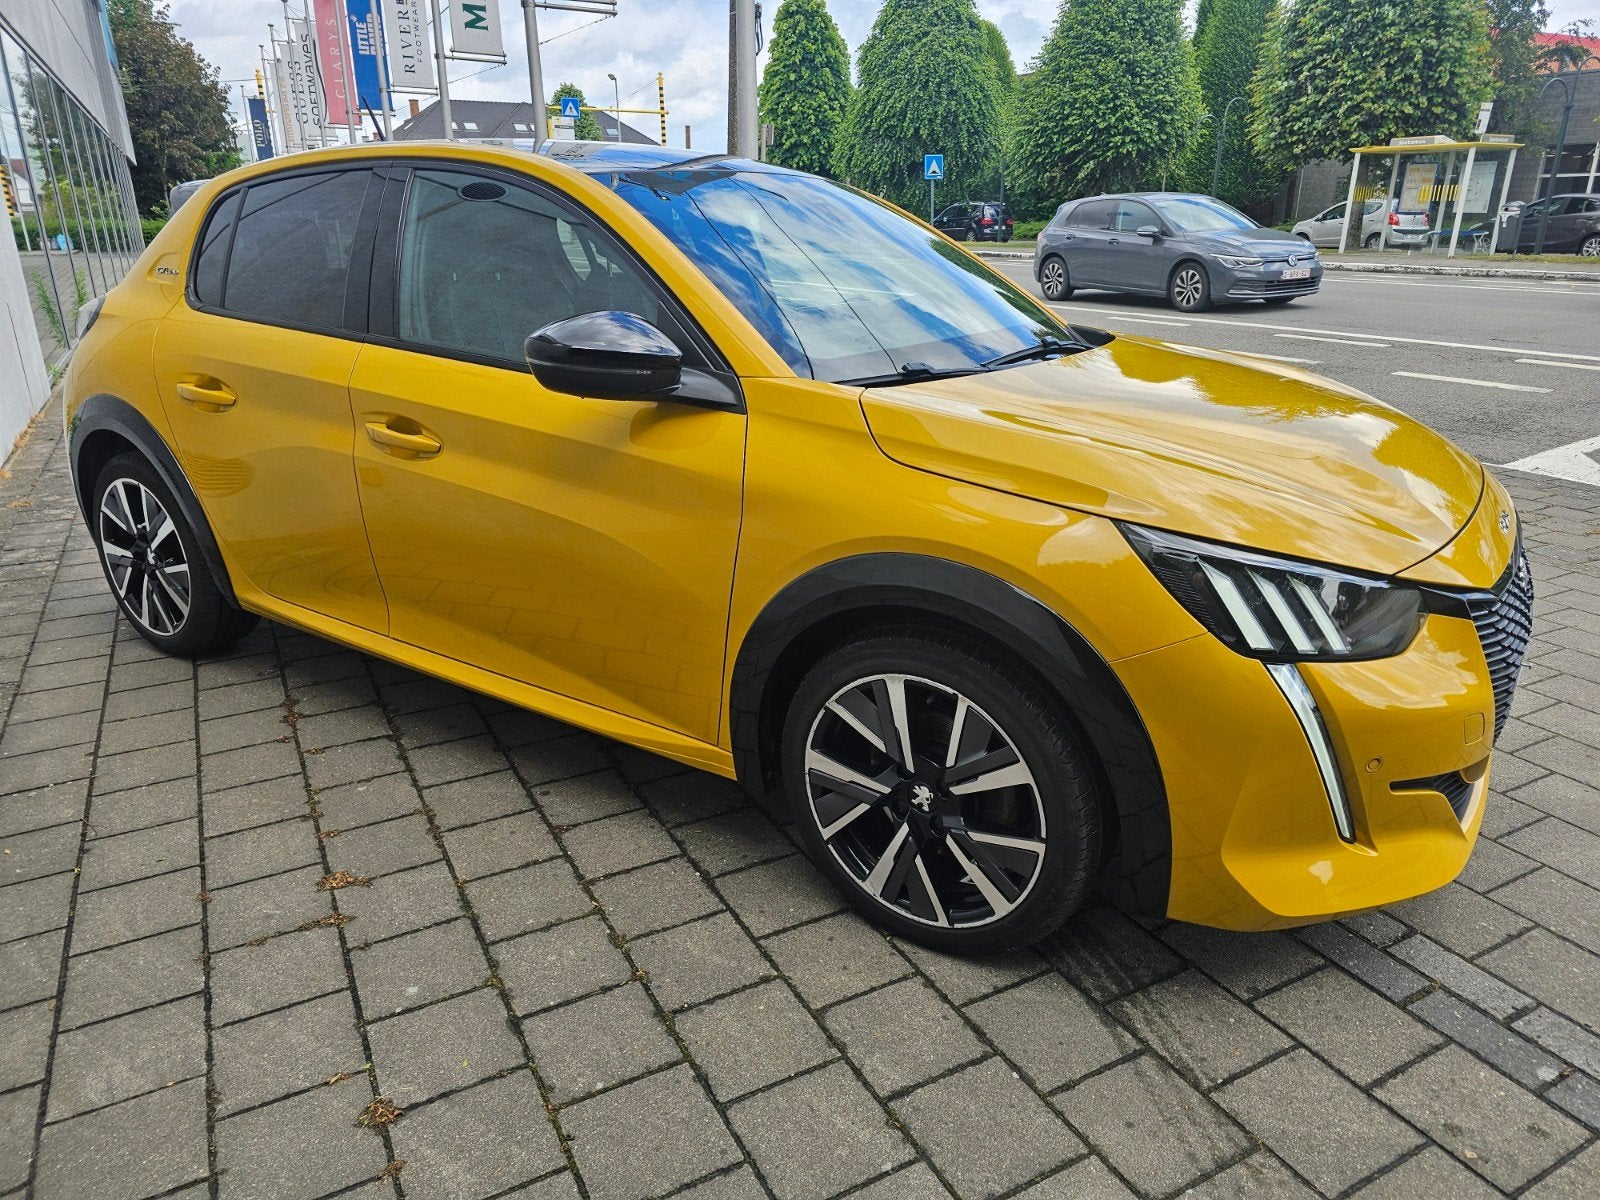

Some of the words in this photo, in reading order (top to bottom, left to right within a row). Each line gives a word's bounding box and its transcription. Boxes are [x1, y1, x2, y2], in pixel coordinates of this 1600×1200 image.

[355, 21, 367, 55] LITTLE
[411, 0, 423, 63] FOOTWEAR
[462, 0, 489, 32] M
[326, 18, 346, 99] CLARYS
[398, 9, 416, 74] RIVER
[253, 118, 265, 148] POLO
